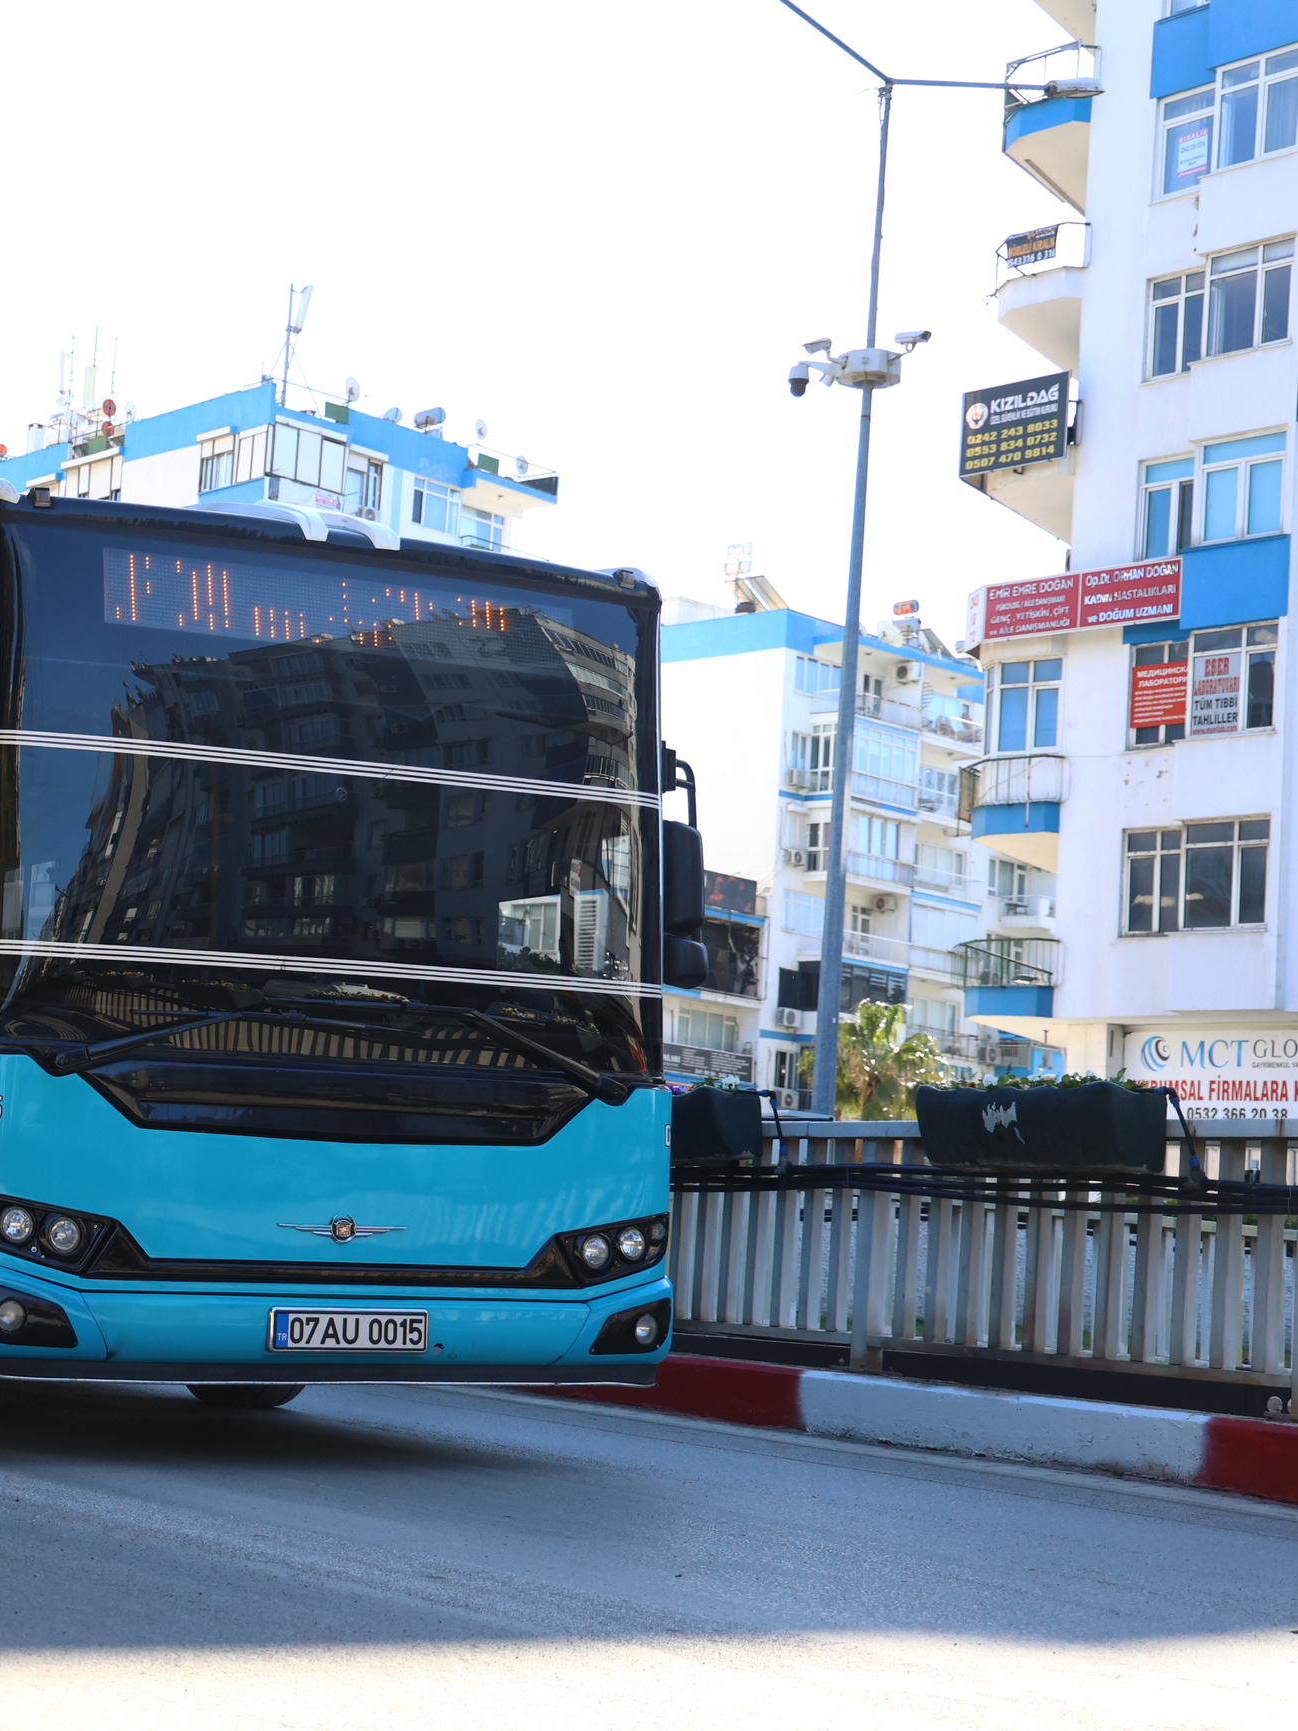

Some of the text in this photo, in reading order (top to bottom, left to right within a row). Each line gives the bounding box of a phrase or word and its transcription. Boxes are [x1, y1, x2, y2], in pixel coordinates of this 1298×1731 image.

[990, 383, 1059, 414] KIZILDAĞ
[966, 419, 1058, 445] 0242 243 8033
[966, 432, 1058, 458] 0553 834 0732
[965, 444, 1056, 470] 0507 470 9814
[1114, 568, 1145, 584] ORHAN
[1146, 561, 1179, 578] DOĞAN
[990, 578, 1074, 600] EMİR EMRE DOĞAN
[1114, 584, 1177, 602] HASTALIKLARI
[1086, 604, 1174, 624] ve DOĞUM UZMANI
[1204, 657, 1230, 677] ESER
[1194, 698, 1212, 711] TÜM
[1215, 694, 1238, 709] TIBBİ
[1192, 712, 1238, 726] TAHLİLLER
[1180, 1040, 1250, 1070] MCT
[1208, 1075, 1289, 1102] FİRMALARA
[1186, 1107, 1218, 1119] 0532
[1222, 1108, 1246, 1119] 366
[277, 1332, 288, 1342] TR
[368, 1318, 422, 1346] 0015
